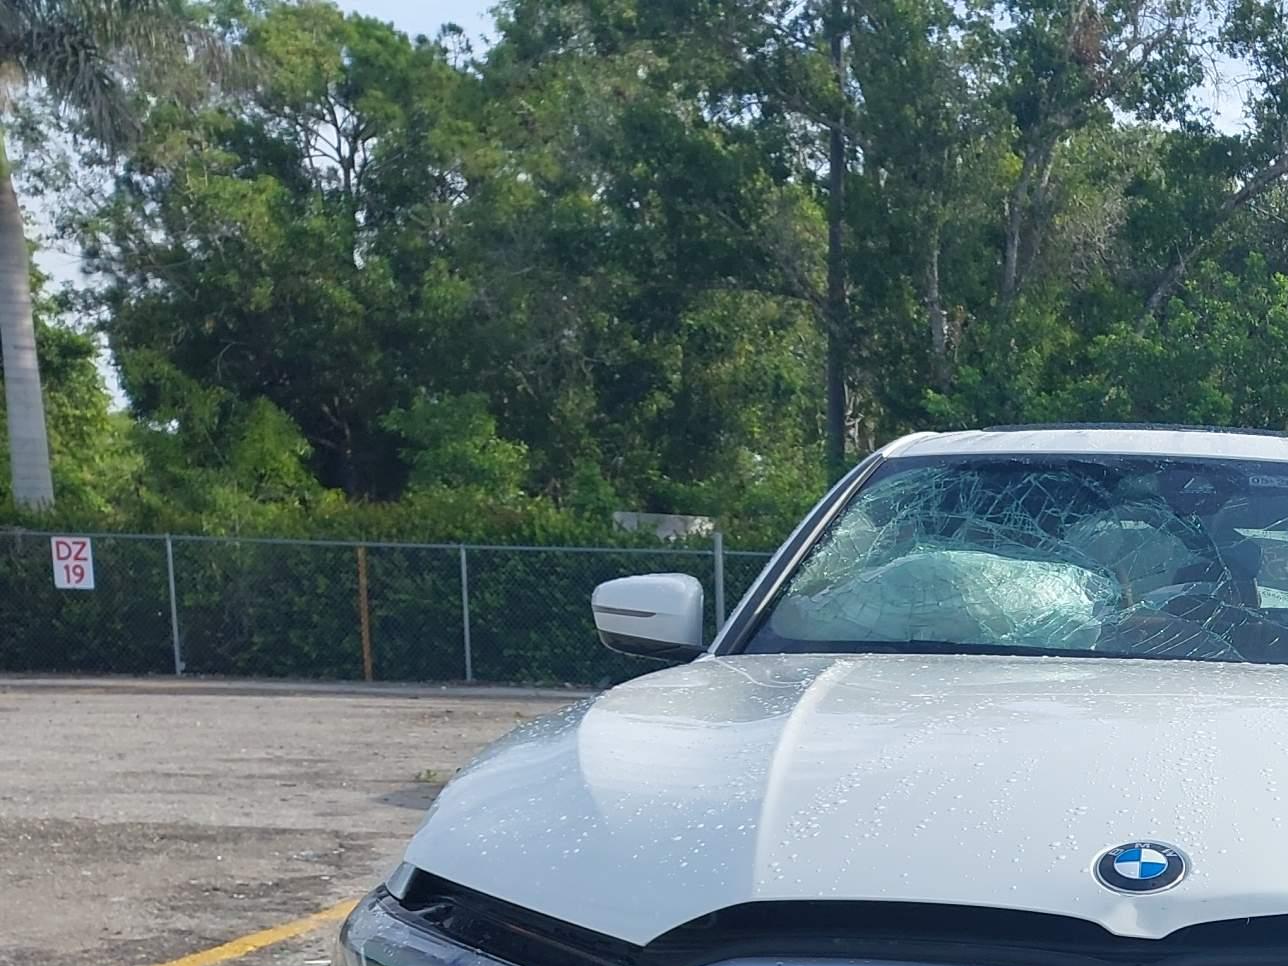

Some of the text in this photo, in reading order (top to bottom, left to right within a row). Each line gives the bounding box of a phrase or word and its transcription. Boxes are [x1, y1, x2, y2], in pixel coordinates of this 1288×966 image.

[55, 541, 88, 561] DZ
[64, 564, 85, 585] 19
[1108, 842, 1178, 857] BMW
